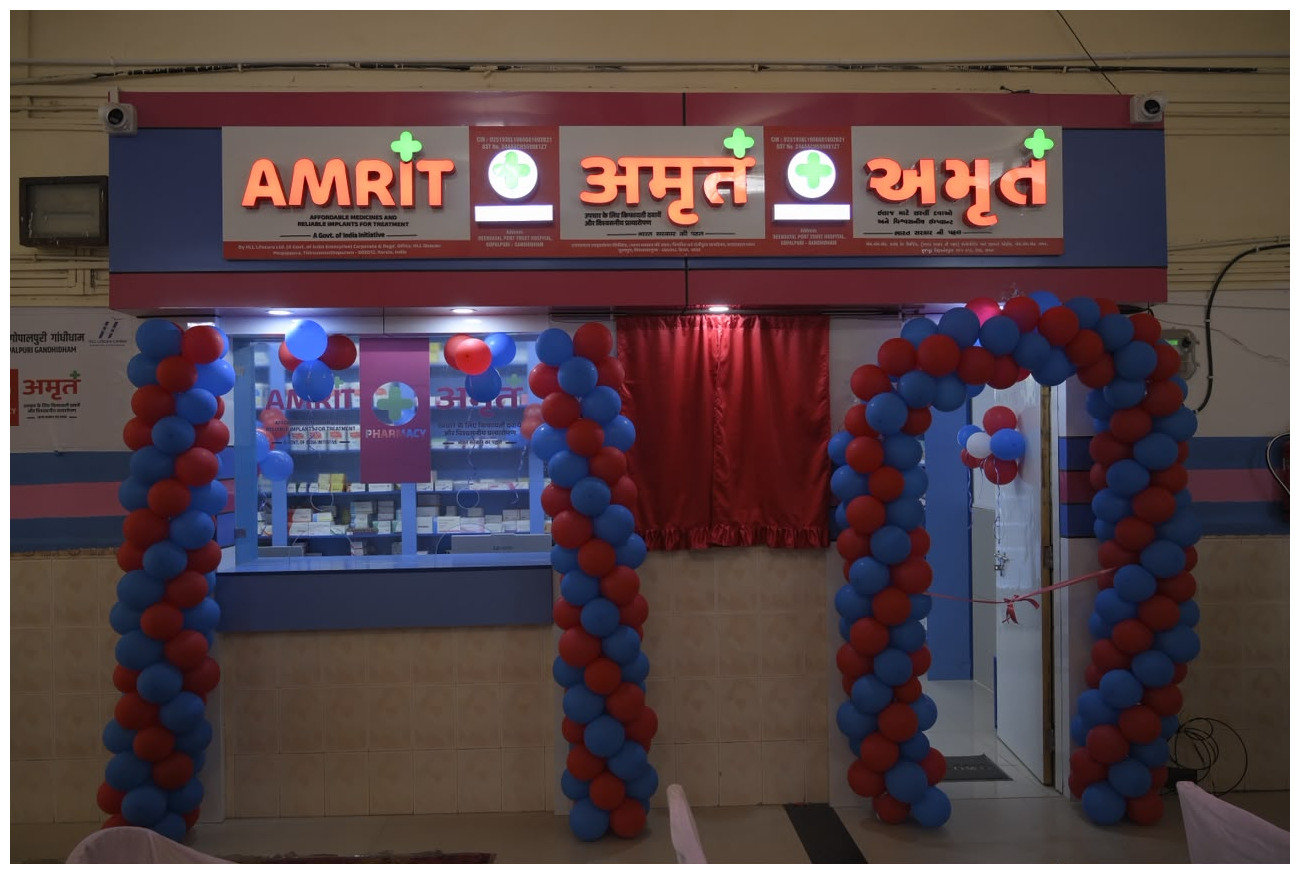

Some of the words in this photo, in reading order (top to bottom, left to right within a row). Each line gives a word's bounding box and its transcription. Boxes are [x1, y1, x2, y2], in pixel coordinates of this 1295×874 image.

[579, 156, 756, 226] अमृत
[864, 157, 1047, 227] અમૃત
[34, 346, 77, 354] GANDHIDHAM
[23, 379, 82, 400] अमृत
